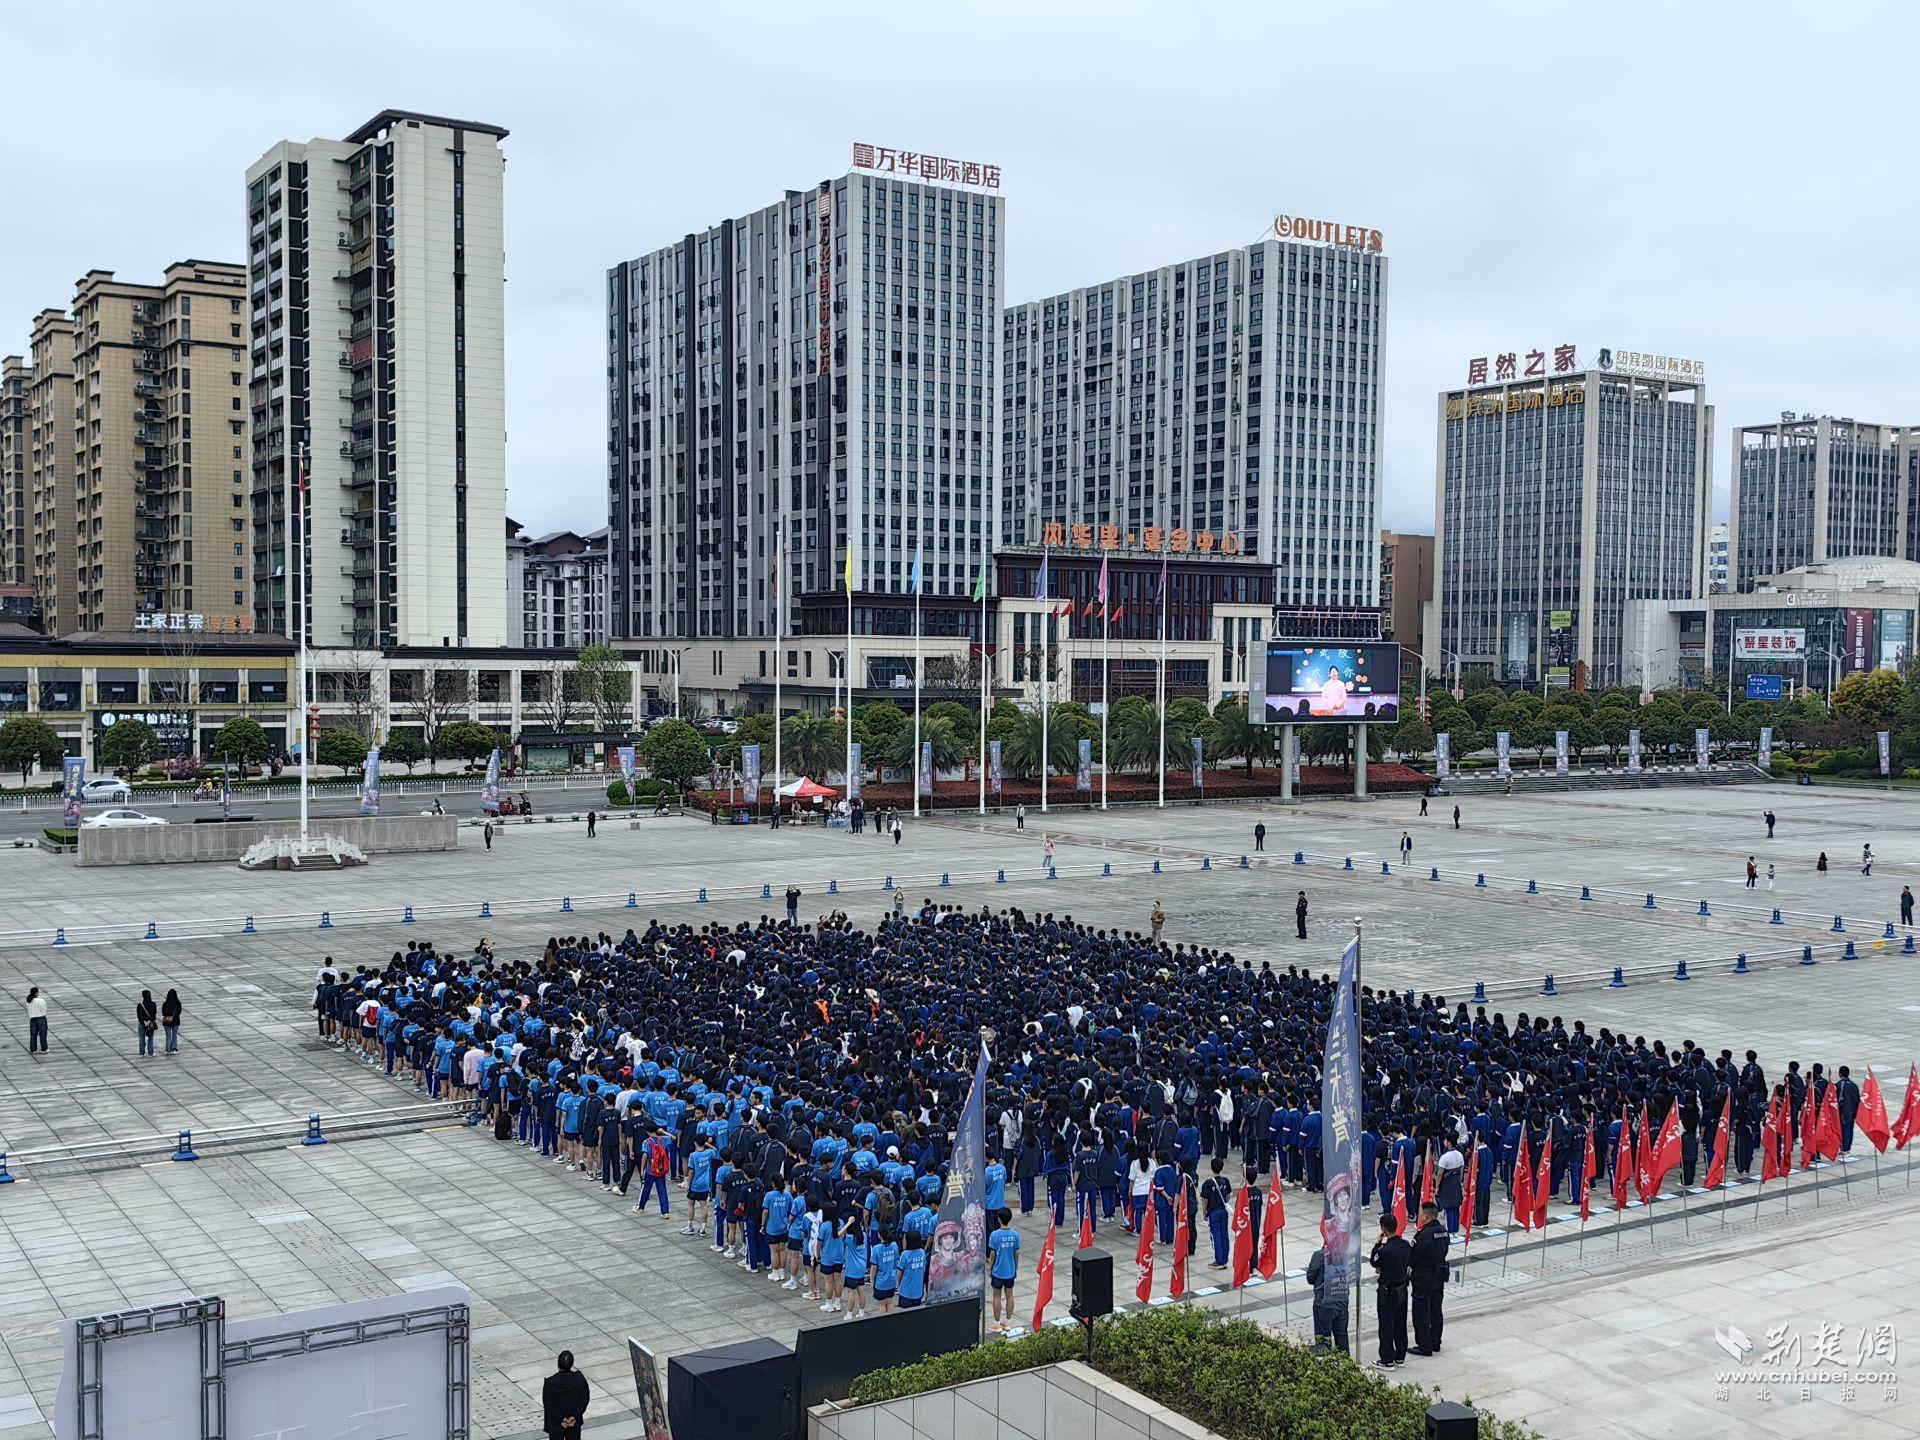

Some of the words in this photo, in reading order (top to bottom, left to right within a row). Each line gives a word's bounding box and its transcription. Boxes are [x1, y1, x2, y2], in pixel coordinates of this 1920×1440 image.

[876, 147, 1001, 188] 万华国际酒店
[1293, 217, 1383, 252] OUTLETS
[1468, 343, 1577, 386] 居然之家
[134, 612, 204, 630] 土家正宗
[1311, 666, 1356, 678] 欢你
